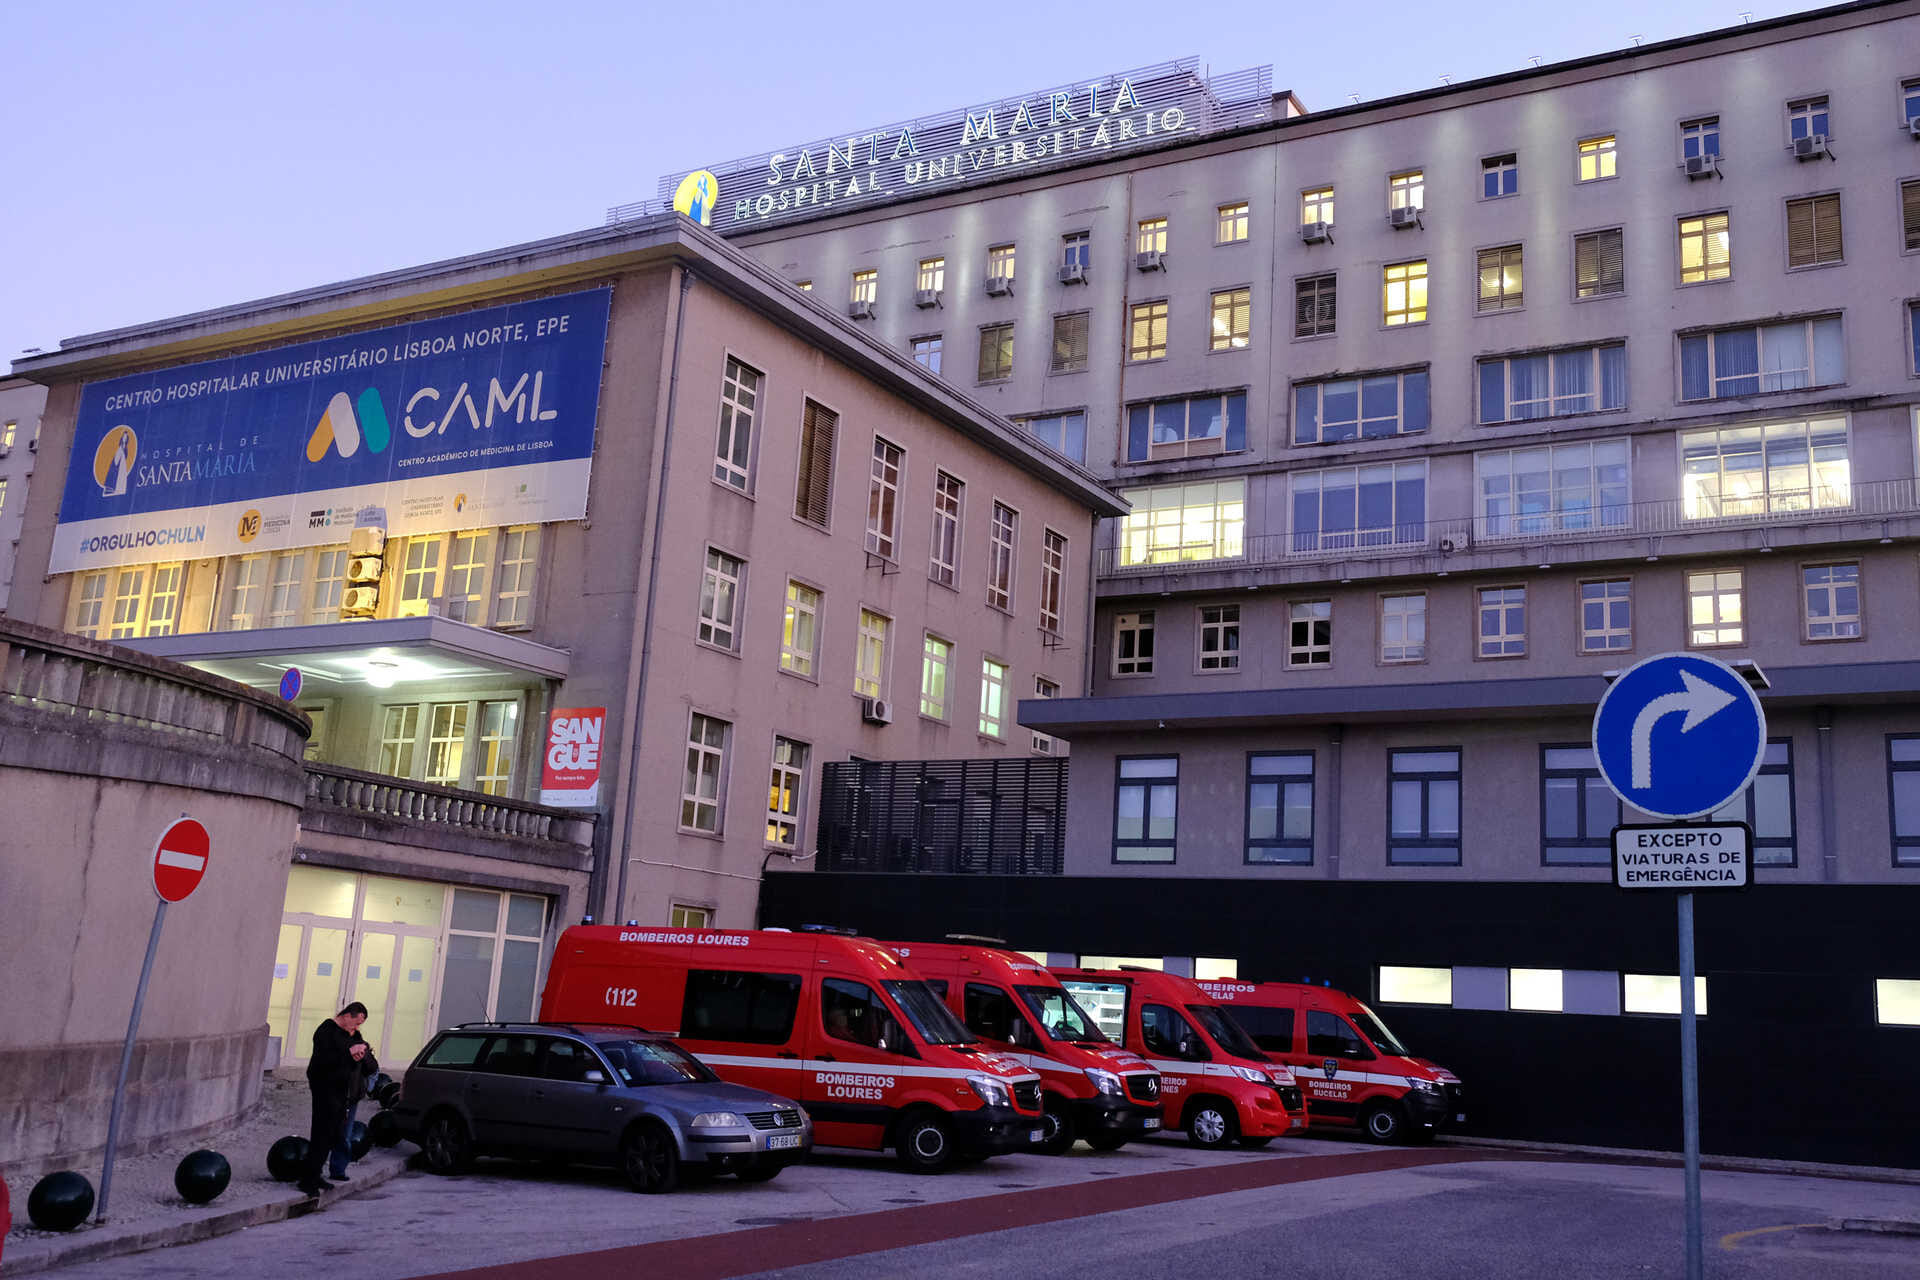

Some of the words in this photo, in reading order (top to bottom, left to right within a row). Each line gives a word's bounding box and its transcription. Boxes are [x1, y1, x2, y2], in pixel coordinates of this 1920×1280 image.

[767, 126, 919, 186] SANTA
[959, 77, 1143, 145] MARIA
[733, 171, 882, 221] HOSPITAL
[904, 107, 1185, 184] UNIVERSITÁRIO
[105, 387, 162, 411] CENTRO
[167, 371, 259, 400] HOSPITALAR
[265, 348, 387, 384] UNIVERSITÁRIO
[393, 336, 456, 361] LISBOA
[463, 323, 528, 349] NORTE,
[536, 315, 570, 337] EPE
[404, 370, 558, 438] CAML
[141, 443, 223, 459] HOSPITAL
[240, 435, 258, 446] DE
[398, 455, 425, 468] CENTRO
[427, 450, 468, 464] ACADÉMICO
[470, 450, 478, 458] DE
[480, 445, 515, 457] MEDICINA
[527, 440, 554, 450] LISBOA
[79, 525, 205, 553] #ORGULHOCHULN
[550, 717, 602, 744] SAN
[548, 743, 599, 770] GUE
[1638, 833, 1722, 847] EXCEPTO
[1622, 853, 1709, 865] VIATURAS
[1719, 852, 1741, 864] DE
[1626, 867, 1736, 882] EMERGÊNCIA
[619, 932, 694, 944] BOMBEIROS
[697, 934, 750, 946] LOURES
[1207, 991, 1234, 1000] ELAS
[816, 1073, 895, 1088] BOMBEIROS
[1309, 1080, 1352, 1091] BOMBEIROS
[827, 1086, 883, 1100] LOURES
